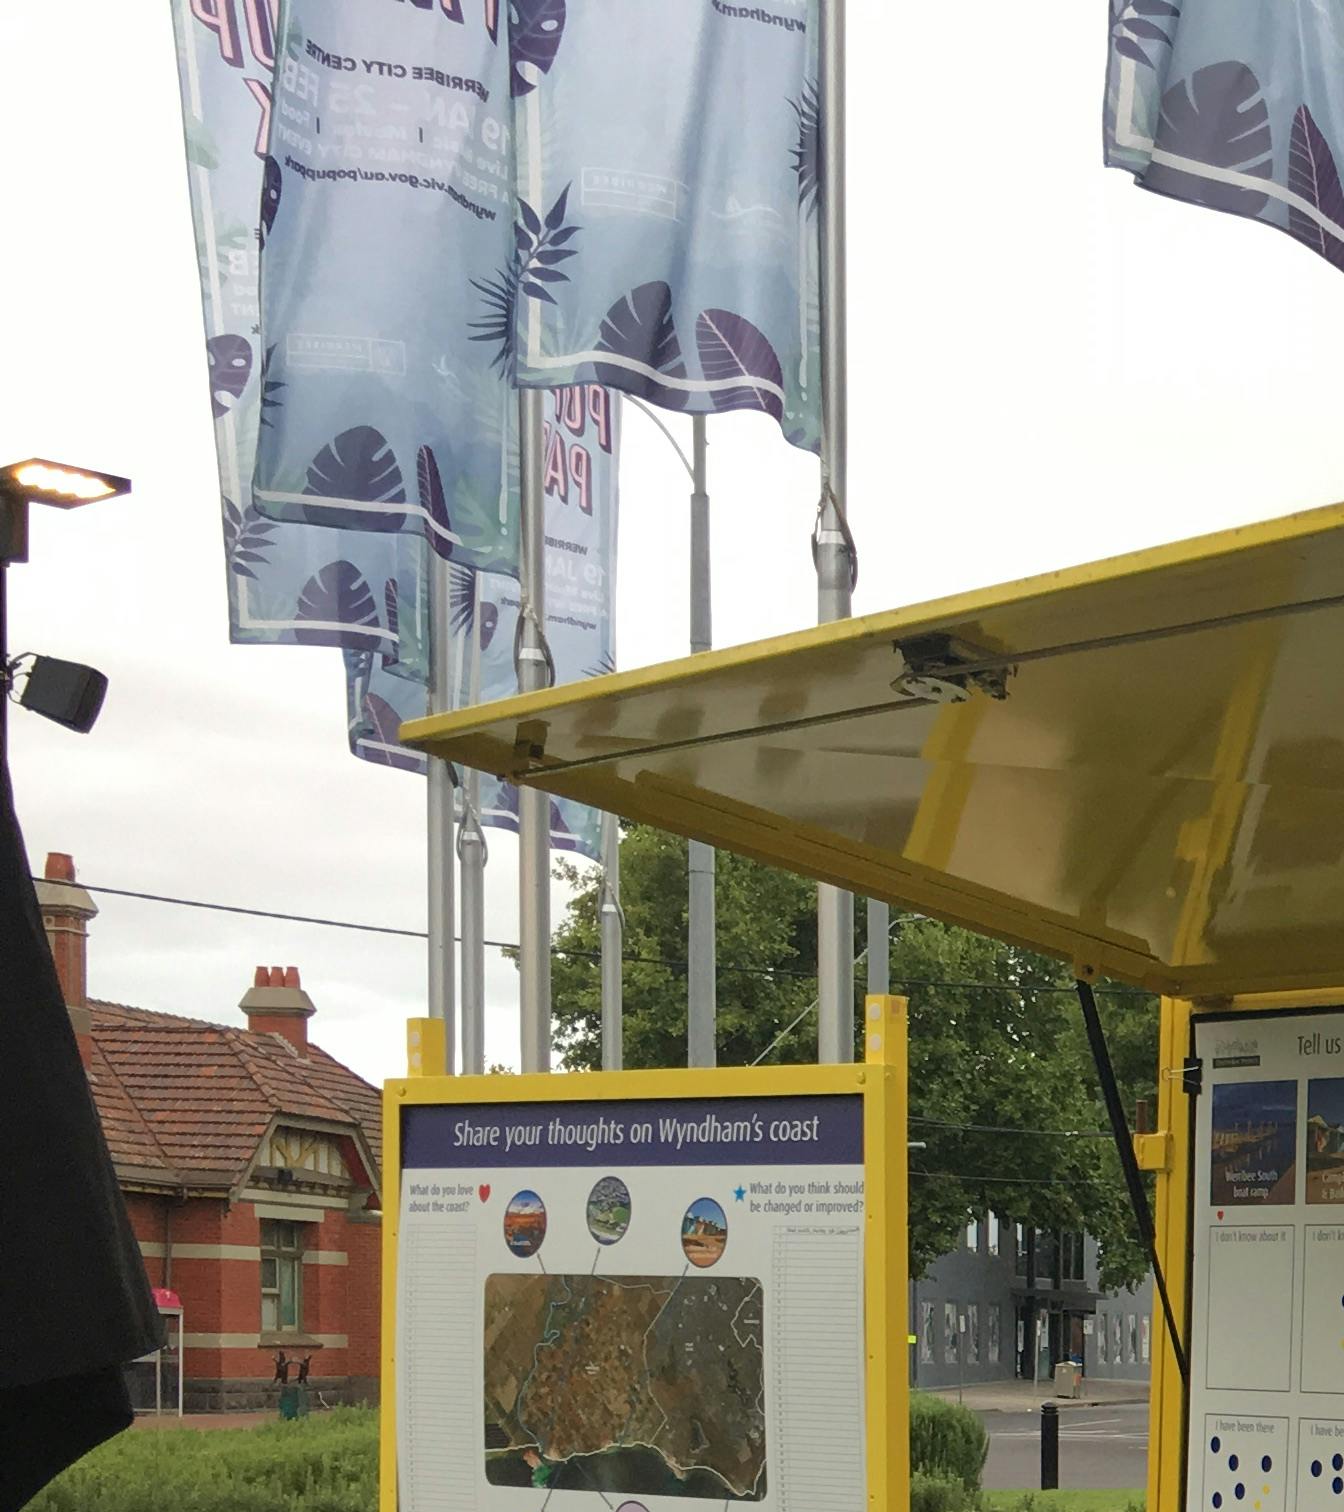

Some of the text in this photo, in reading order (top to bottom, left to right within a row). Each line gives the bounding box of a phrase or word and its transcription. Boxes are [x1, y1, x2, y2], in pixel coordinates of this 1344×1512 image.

[1297, 1033, 1321, 1056] Tell
[1325, 1037, 1341, 1054] us
[454, 1113, 819, 1151] Share your thoughts on Wyndham's coast
[410, 1183, 474, 1198] What do you love
[750, 1181, 864, 1197] What do you think should
[409, 1201, 430, 1212] about
[750, 1199, 864, 1215] be changed or improved?
